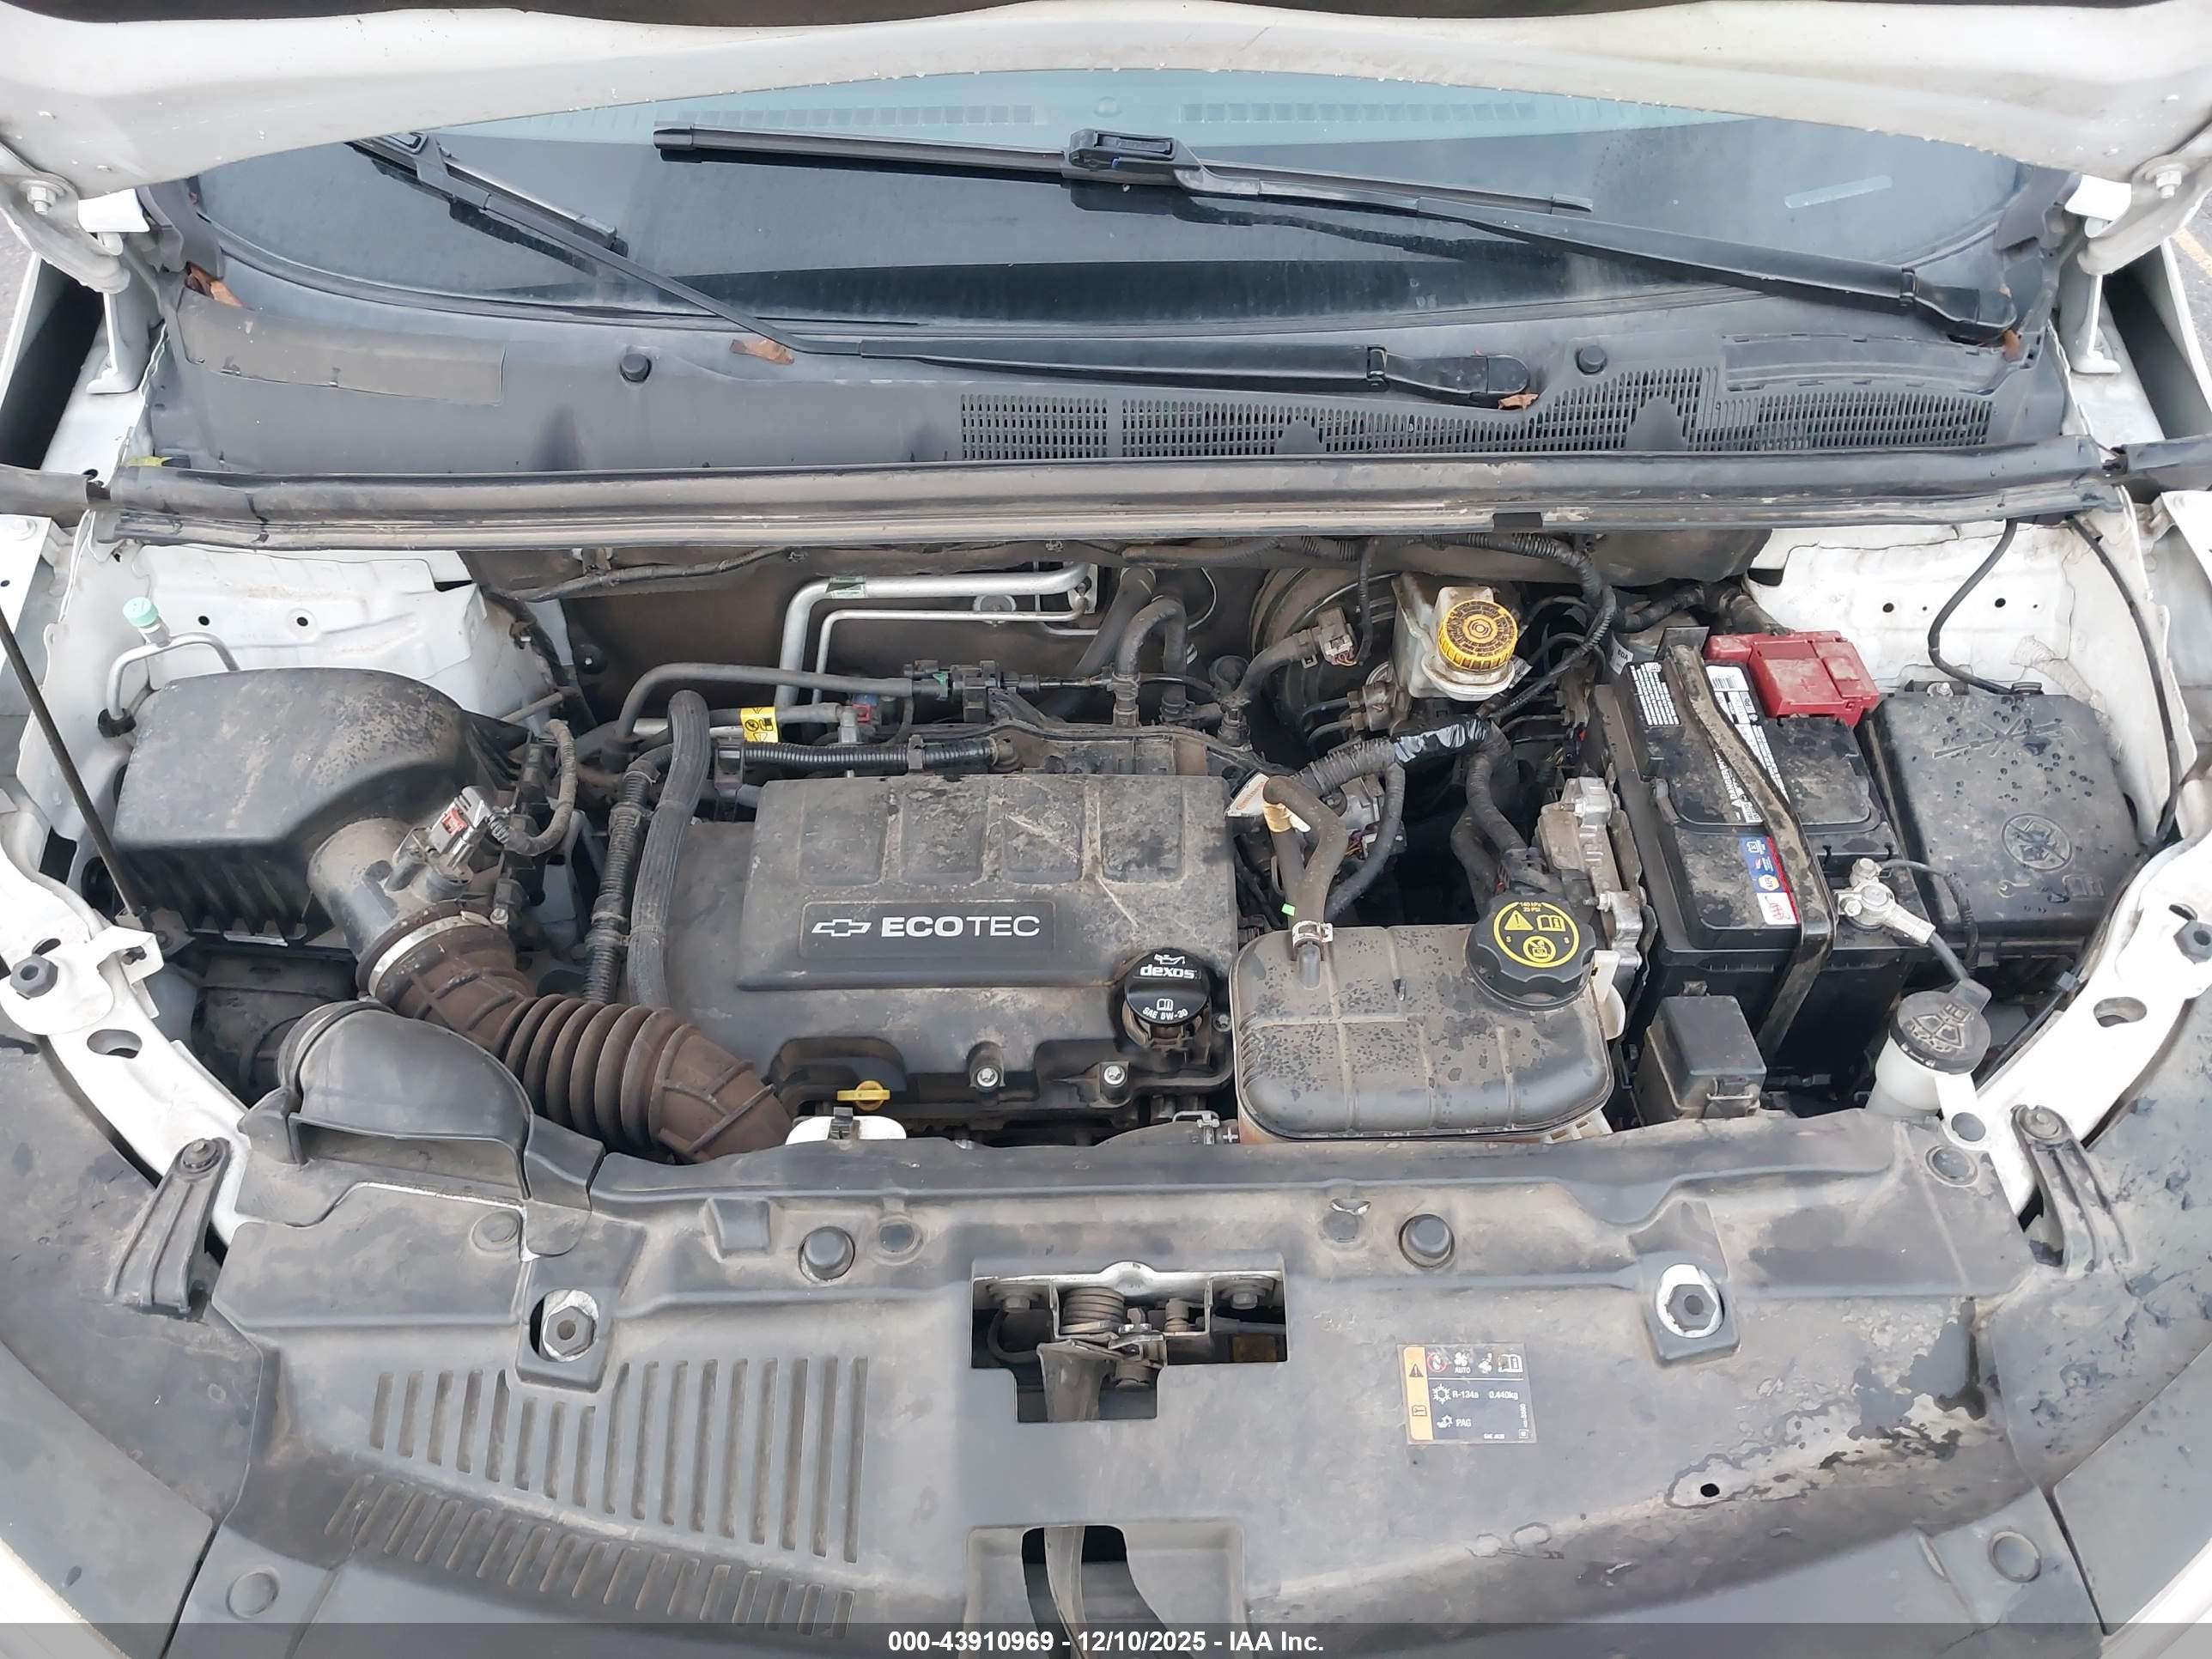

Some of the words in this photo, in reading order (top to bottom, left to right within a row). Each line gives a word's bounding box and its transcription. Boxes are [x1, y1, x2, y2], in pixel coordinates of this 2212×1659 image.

[1744, 697, 1753, 708] Pb
[881, 916, 1040, 938] ECOTEC
[1140, 964, 1195, 979] dexos
[1142, 1006, 1158, 1019] SAE
[1488, 1391, 1519, 1401] 0.440kg
[1455, 1418, 1472, 1427] PAG
